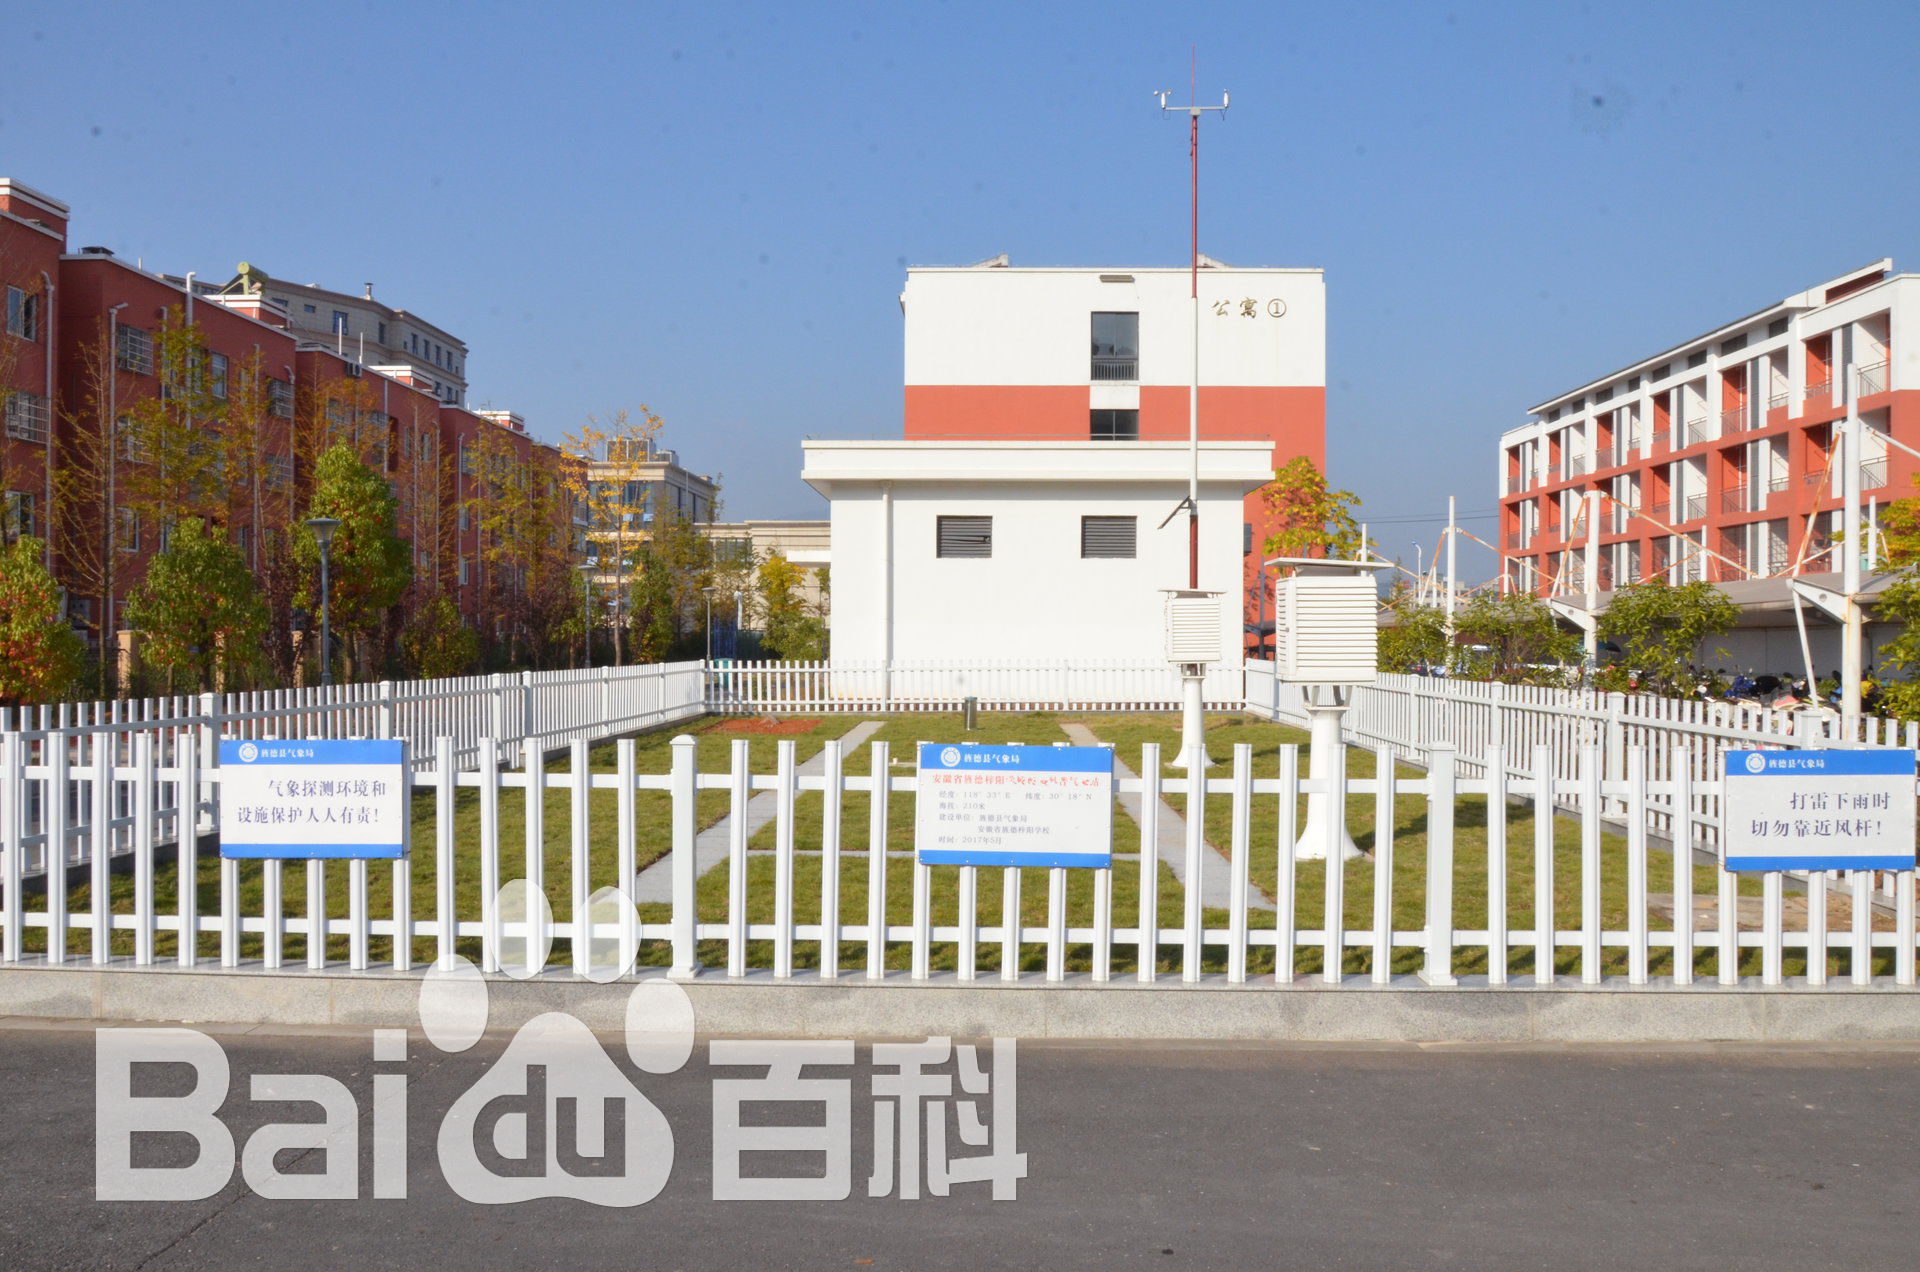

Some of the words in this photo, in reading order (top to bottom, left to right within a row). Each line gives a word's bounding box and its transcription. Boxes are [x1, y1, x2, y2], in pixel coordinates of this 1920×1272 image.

[261, 748, 314, 759] 旌德县气象局
[964, 753, 1020, 764] 旌德县气象局
[1769, 759, 1825, 769] 旌德县气象局
[268, 780, 386, 797] 气象探测环境和
[1790, 792, 1890, 810] 打雷下雨时
[238, 806, 379, 824] 设施保护人人有责！
[1752, 819, 1881, 837] 切勿靠近风杆！
